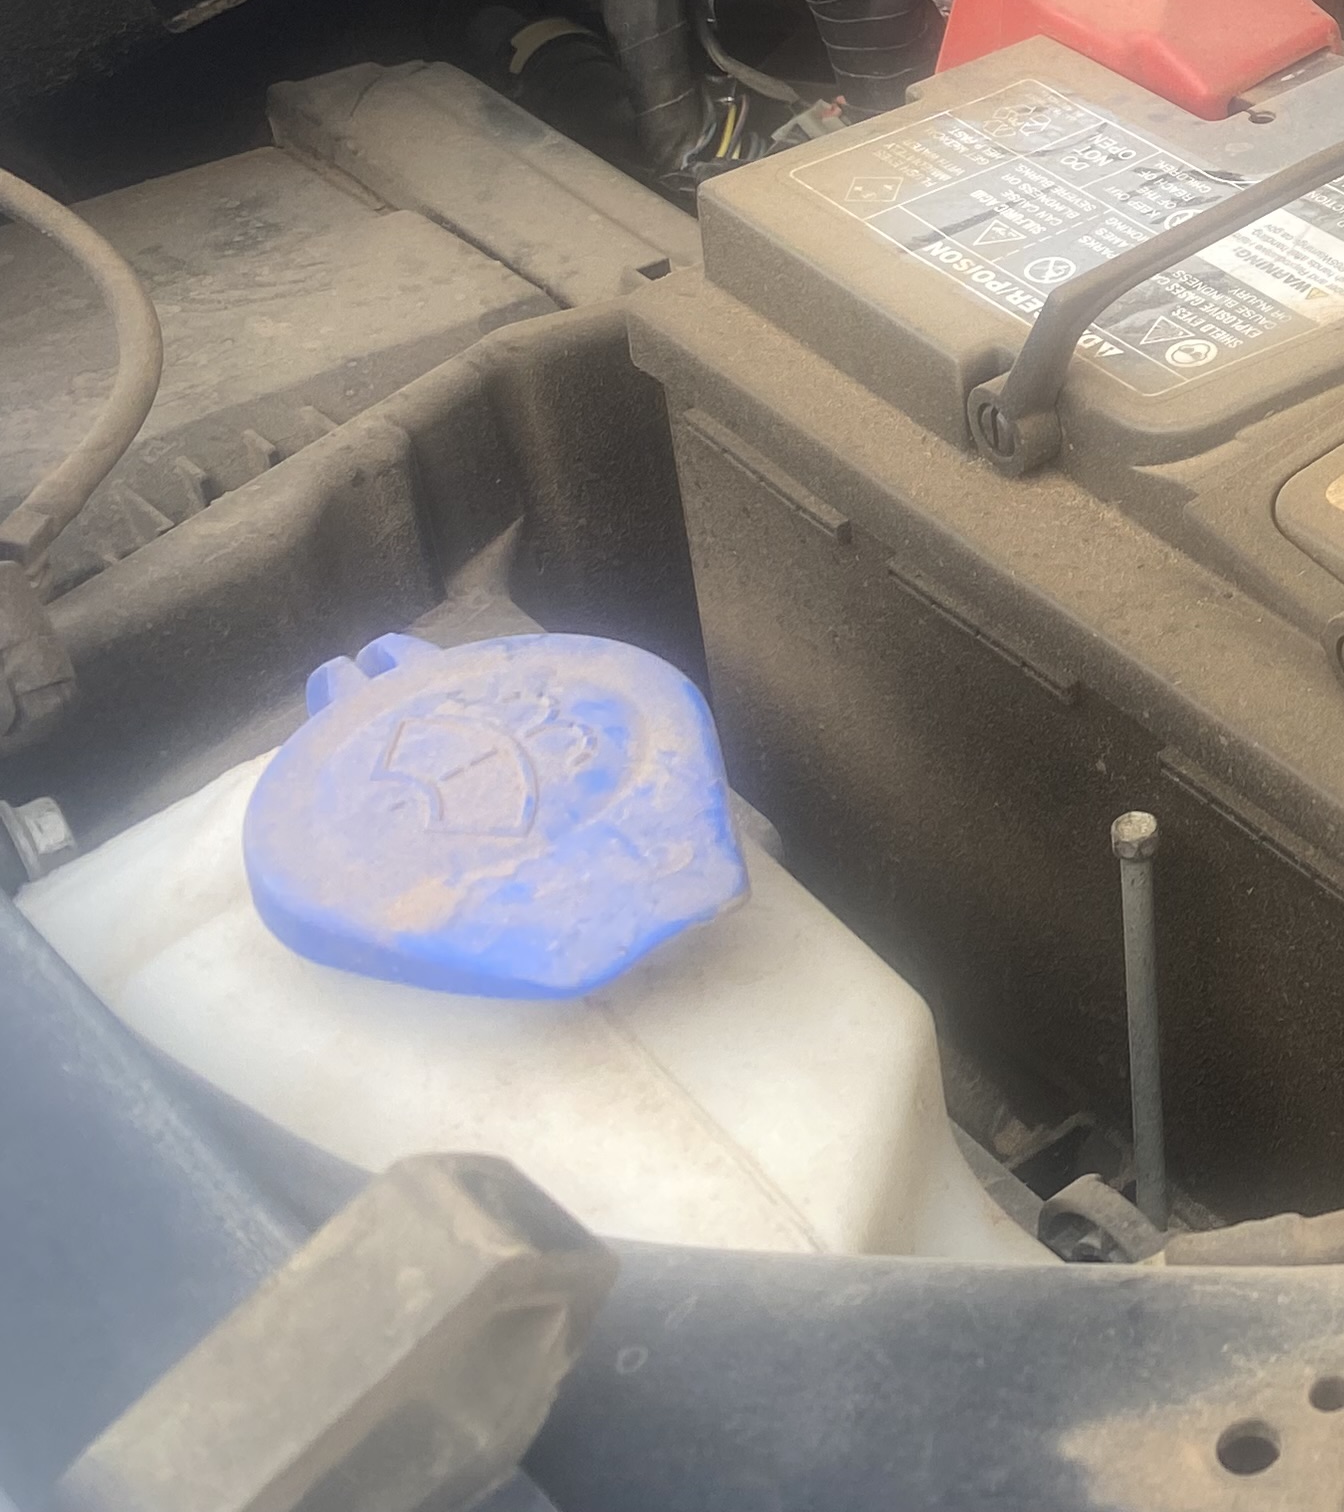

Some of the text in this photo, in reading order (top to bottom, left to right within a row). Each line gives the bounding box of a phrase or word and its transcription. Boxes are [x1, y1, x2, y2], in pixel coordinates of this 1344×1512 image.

[1055, 154, 1092, 171] DO
[1070, 143, 1116, 166] NOT
[998, 172, 1081, 219] BLINDNESS OR
[1047, 185, 1098, 211] SEVERE
[1133, 185, 1179, 209] OF THE
[1135, 168, 1196, 201] REACH OF
[968, 188, 1049, 235] SULFURIC ACID
[998, 188, 1064, 226] CAN CAUSE
[1100, 184, 1162, 218] KEEP OUT
[1091, 226, 1137, 250] AMES
[1101, 216, 1151, 243] MOKING
[1075, 234, 1121, 259] PARKS
[920, 240, 1104, 349] DER/POISON
[1147, 272, 1264, 338] EXPLOSIVE GASES CA
[1169, 268, 1280, 330] CAUSE BLINDNESS
[1197, 322, 1246, 348] SHIELD
